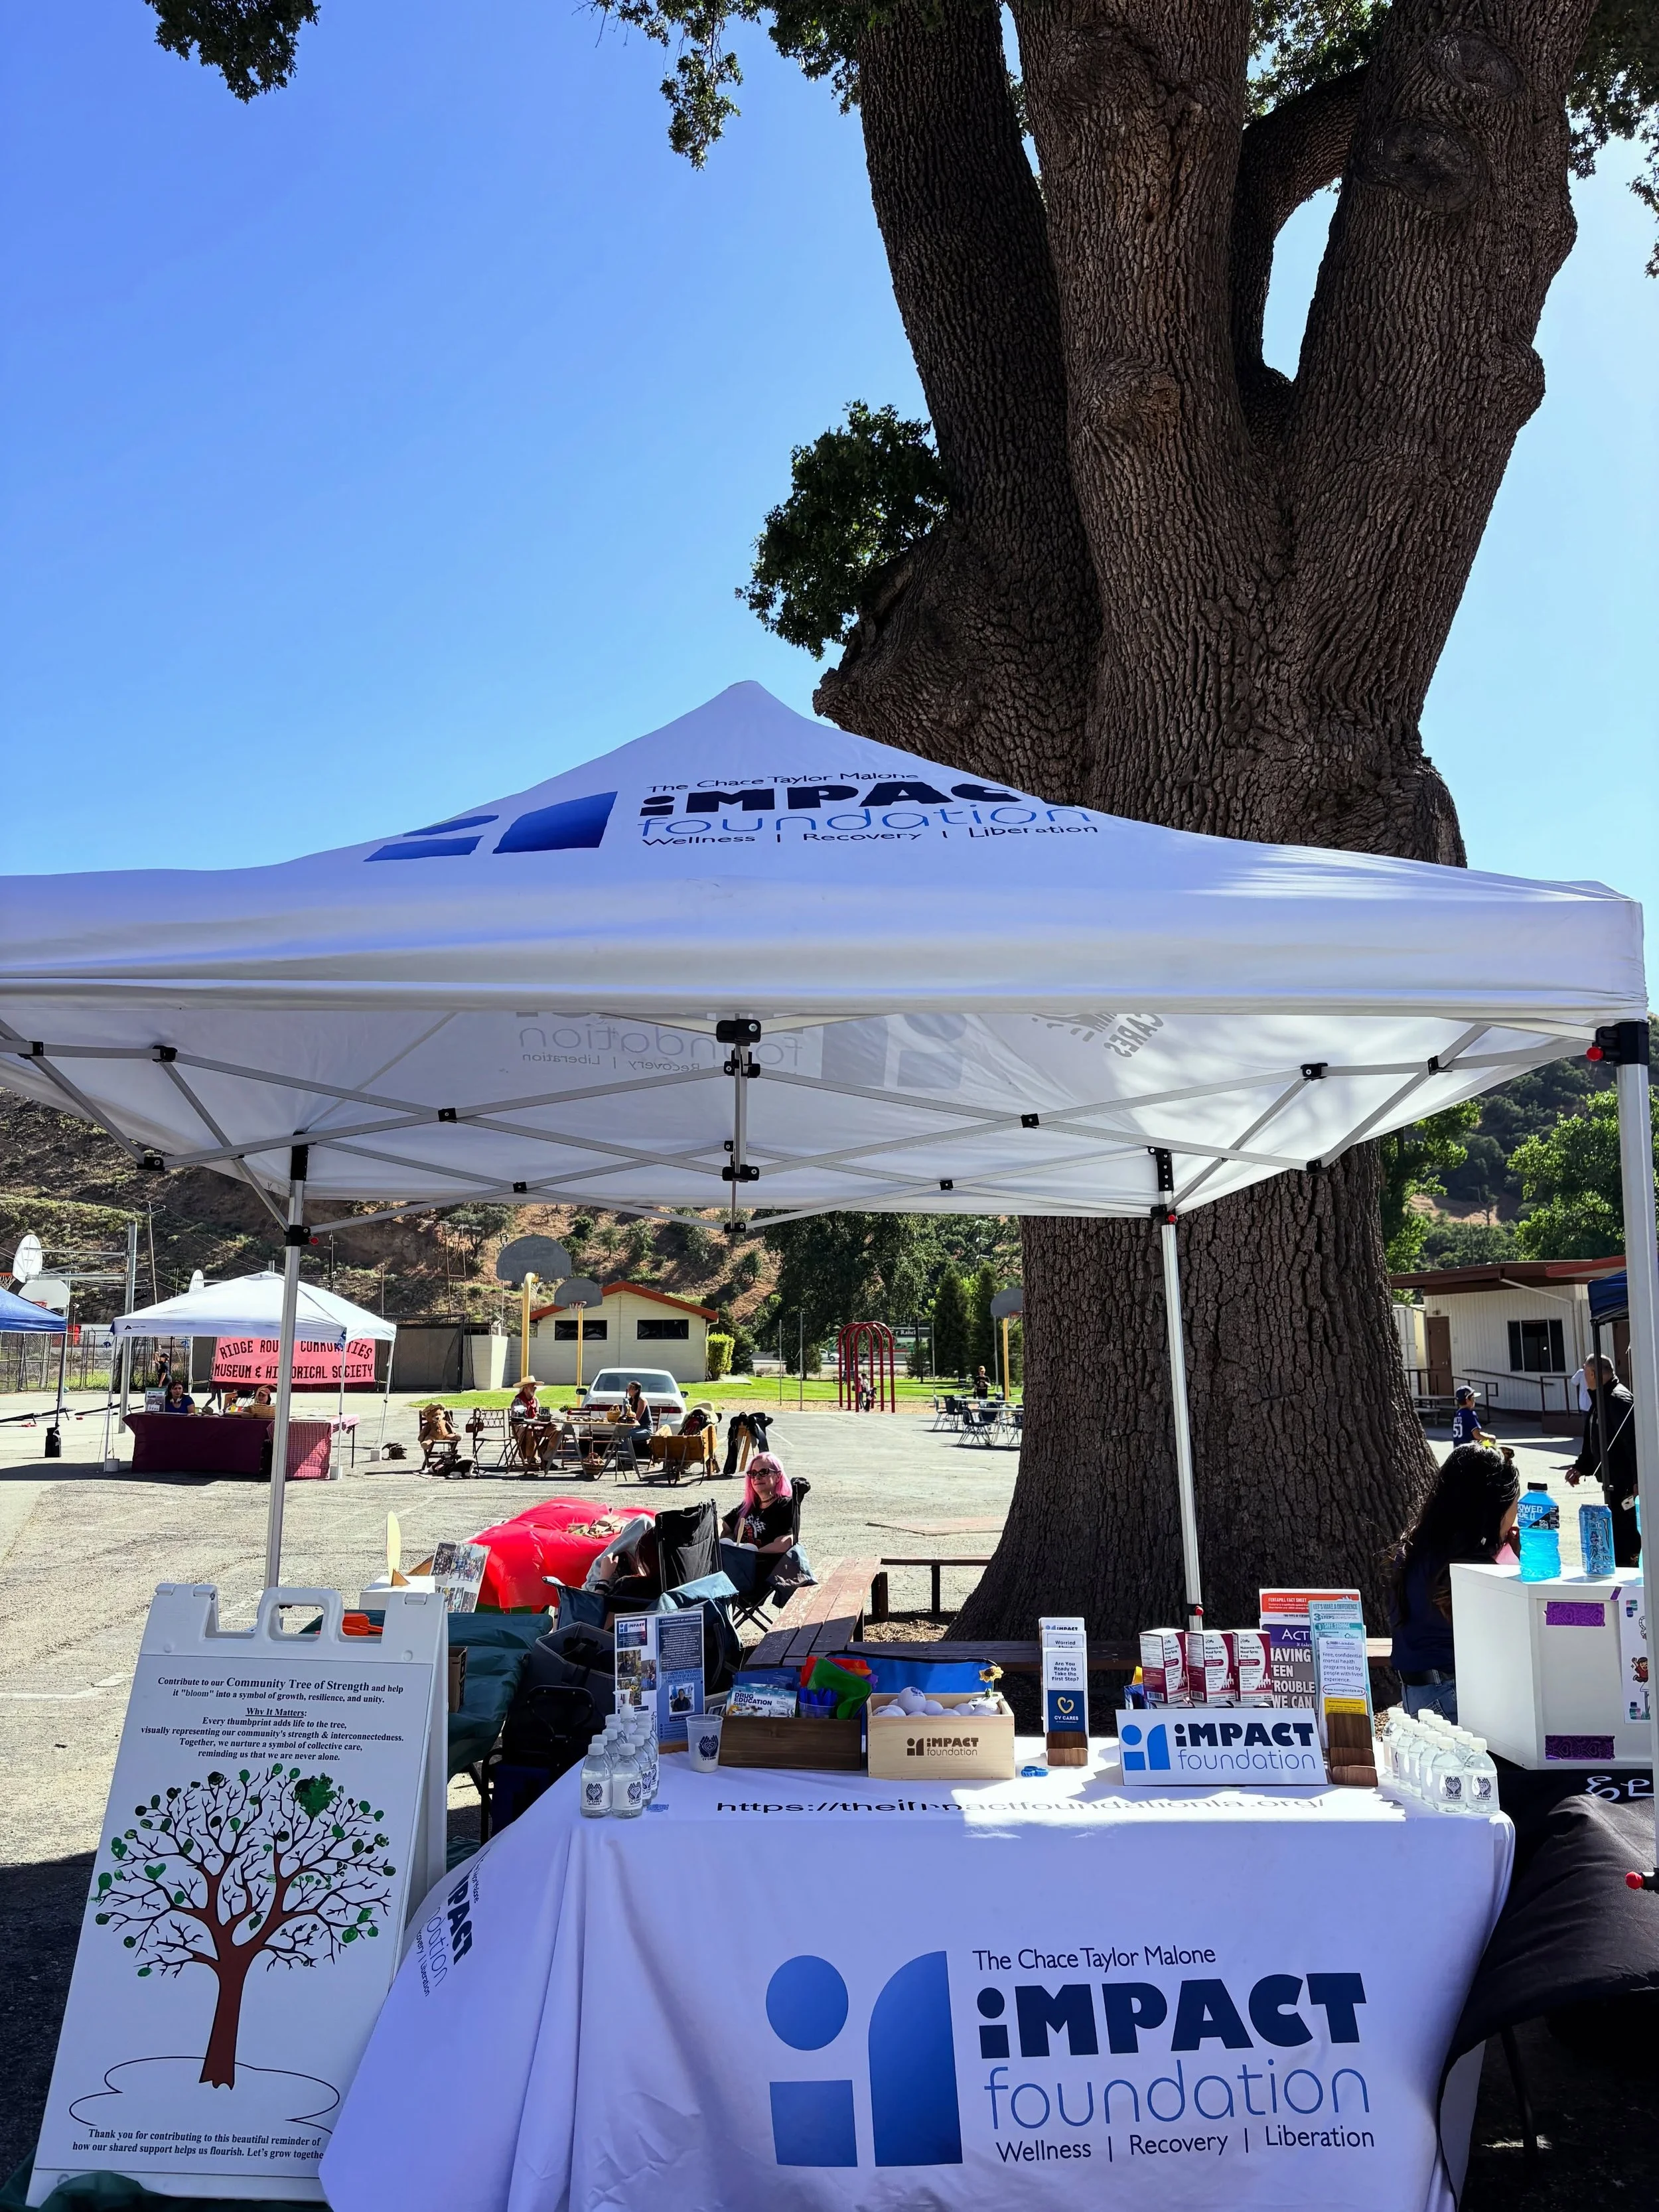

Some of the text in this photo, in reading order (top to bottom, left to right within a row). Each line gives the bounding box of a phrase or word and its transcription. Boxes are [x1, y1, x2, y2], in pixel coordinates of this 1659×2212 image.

[646, 772, 918, 793] The Chace Taylor Malone
[640, 780, 1075, 816] iMPAC
[638, 804, 1091, 836] foundation
[642, 825, 1098, 846] Wellness Recovery Liberation
[219, 1340, 373, 1359] RIDGE ROU COMMUTIES
[214, 1364, 374, 1378] MUSEUM & HIORICAL SOCIETY
[1271, 1664, 1294, 1677] EEN
[158, 1676, 199, 1686] Contribute
[226, 1677, 286, 1690] Community
[289, 1679, 312, 1689] Tree
[314, 1680, 325, 1690] of
[326, 1680, 370, 1693] Strength
[388, 1684, 403, 1694] help
[1271, 1680, 1315, 1694] ROUBLE
[181, 1689, 214, 1698] "bloom"
[216, 1690, 231, 1698] into
[239, 1691, 266, 1700] symbol
[276, 1692, 306, 1702] growth,
[308, 1694, 345, 1702] resilience,
[363, 1695, 385, 1704] unity.
[734, 1697, 772, 1706] EDUCATION
[1291, 1695, 1313, 1708] CAN
[266, 1708, 273, 1716] It
[274, 1708, 307, 1718] Matters:
[202, 1717, 226, 1727] Every
[227, 1718, 271, 1728] thumbprint
[141, 1726, 171, 1736] visually
[172, 1728, 220, 1737] representing
[237, 1730, 286, 1739] community's
[287, 1732, 319, 1740] strength
[330, 1732, 404, 1742] interconnectedness.
[926, 1737, 979, 1747] iMPACT
[1174, 1722, 1314, 1747] iMPACT
[179, 1737, 216, 1747] Together,
[230, 1739, 260, 1748] nurture
[269, 1741, 296, 1750] symbol
[307, 1741, 342, 1750] collective
[198, 1749, 238, 1759] reminding
[250, 1750, 265, 1759] that
[318, 1753, 340, 1761] alone.
[1178, 1749, 1316, 1770] foundation
[447, 1874, 472, 1965] PACT
[425, 1907, 448, 1987] dation
[972, 1945, 1216, 1973] The Chace Taylor Malone
[976, 1972, 1367, 2059] iMPACT
[983, 2058, 1370, 2130] foundation
[88, 2129, 322, 2147] Thank you for contributing to this beautiful reminder of
[995, 2125, 1376, 2164] Wellness Recovery Liberation
[72, 2142, 90, 2150] how
[108, 2143, 138, 2152] shared
[139, 2145, 173, 2156] support
[174, 2146, 196, 2156] helps
[210, 2146, 245, 2156] flourish.
[269, 2150, 291, 2159] grow
[293, 2150, 325, 2161] togethe
